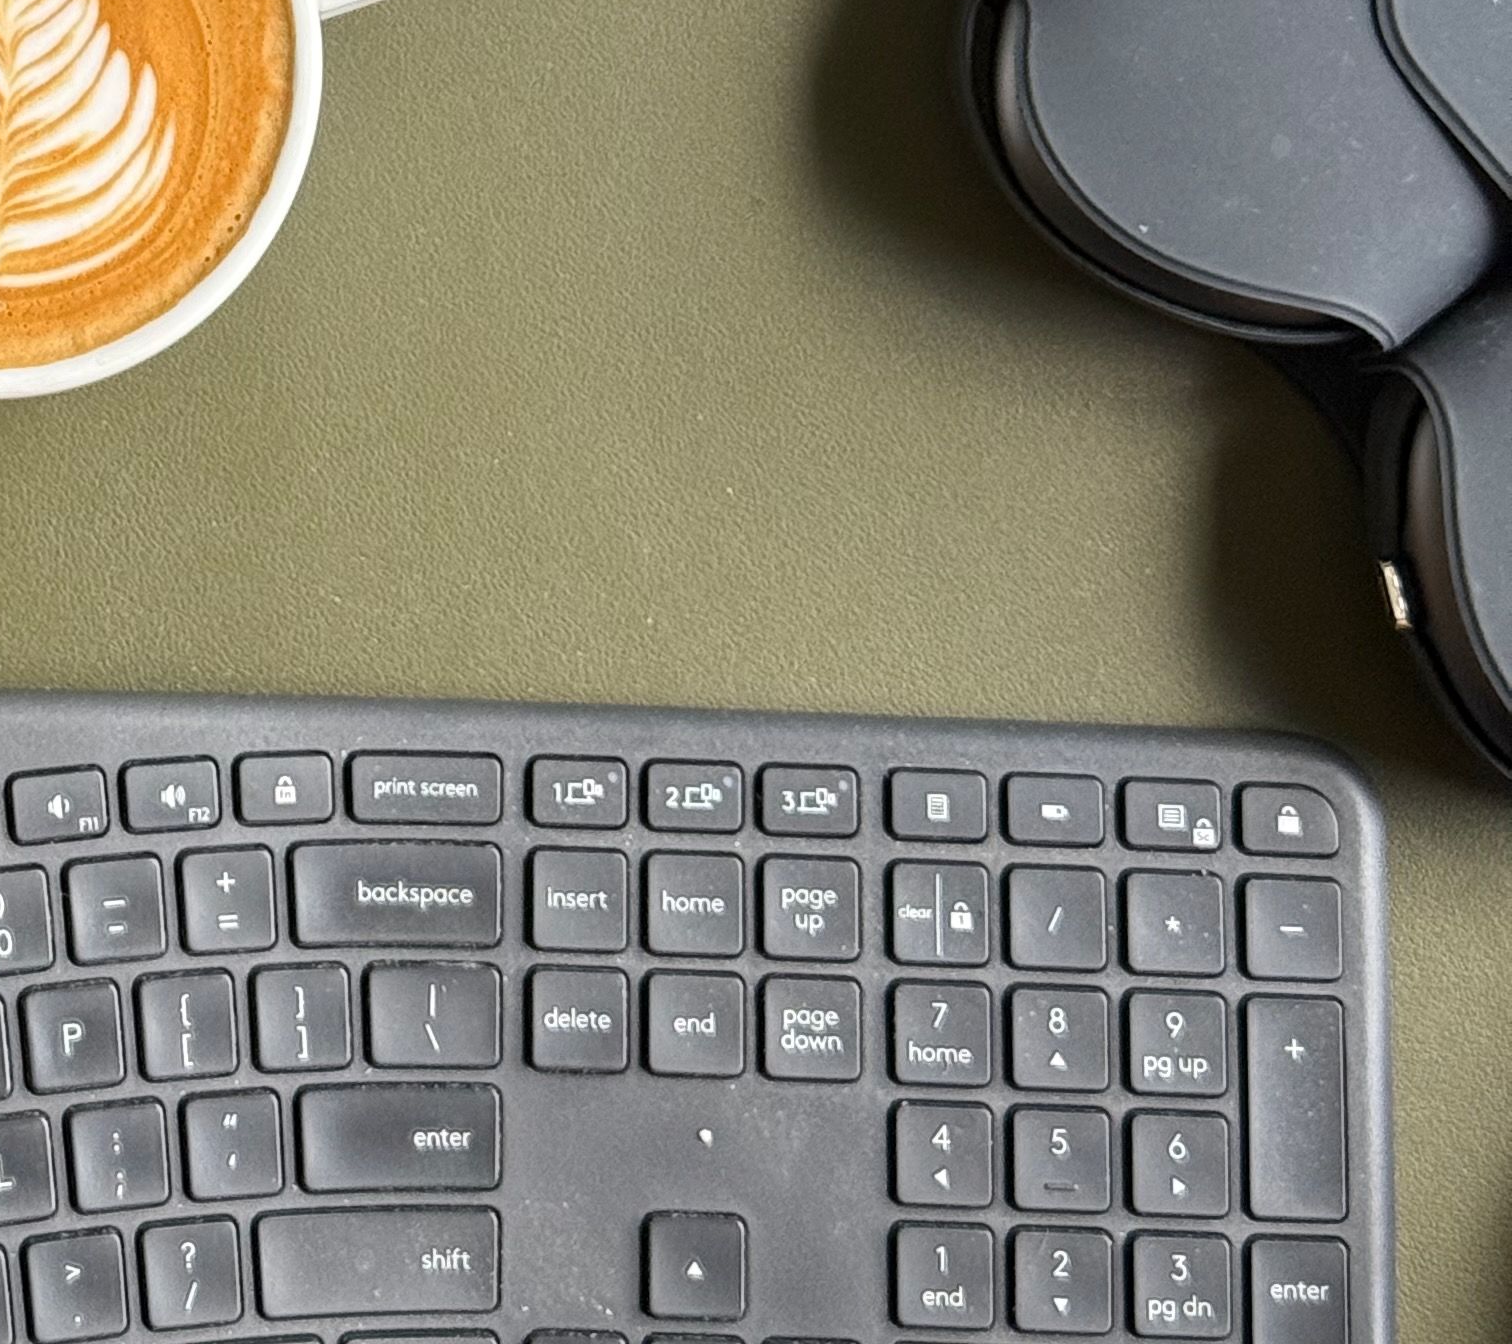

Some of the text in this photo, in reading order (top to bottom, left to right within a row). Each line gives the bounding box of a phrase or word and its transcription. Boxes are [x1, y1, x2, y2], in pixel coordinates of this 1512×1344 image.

[373, 777, 479, 799] print screen
[79, 816, 100, 833] F11
[189, 805, 211, 822] F12
[356, 879, 474, 907] backspace
[546, 888, 609, 911] insert
[661, 892, 725, 915] home
[781, 887, 838, 912] page
[794, 914, 824, 934] up
[898, 904, 933, 922] clear
[544, 1008, 612, 1032] delete
[673, 1013, 716, 1036] end
[782, 1008, 839, 1033] page
[780, 1030, 843, 1054] down
[908, 1042, 973, 1067] home
[1143, 1055, 1209, 1079] pg up
[413, 1128, 470, 1150] enter
[421, 1248, 470, 1271] shift
[922, 1285, 965, 1309] end
[1270, 1280, 1331, 1302] enter
[1147, 1293, 1213, 1321] pg dn
